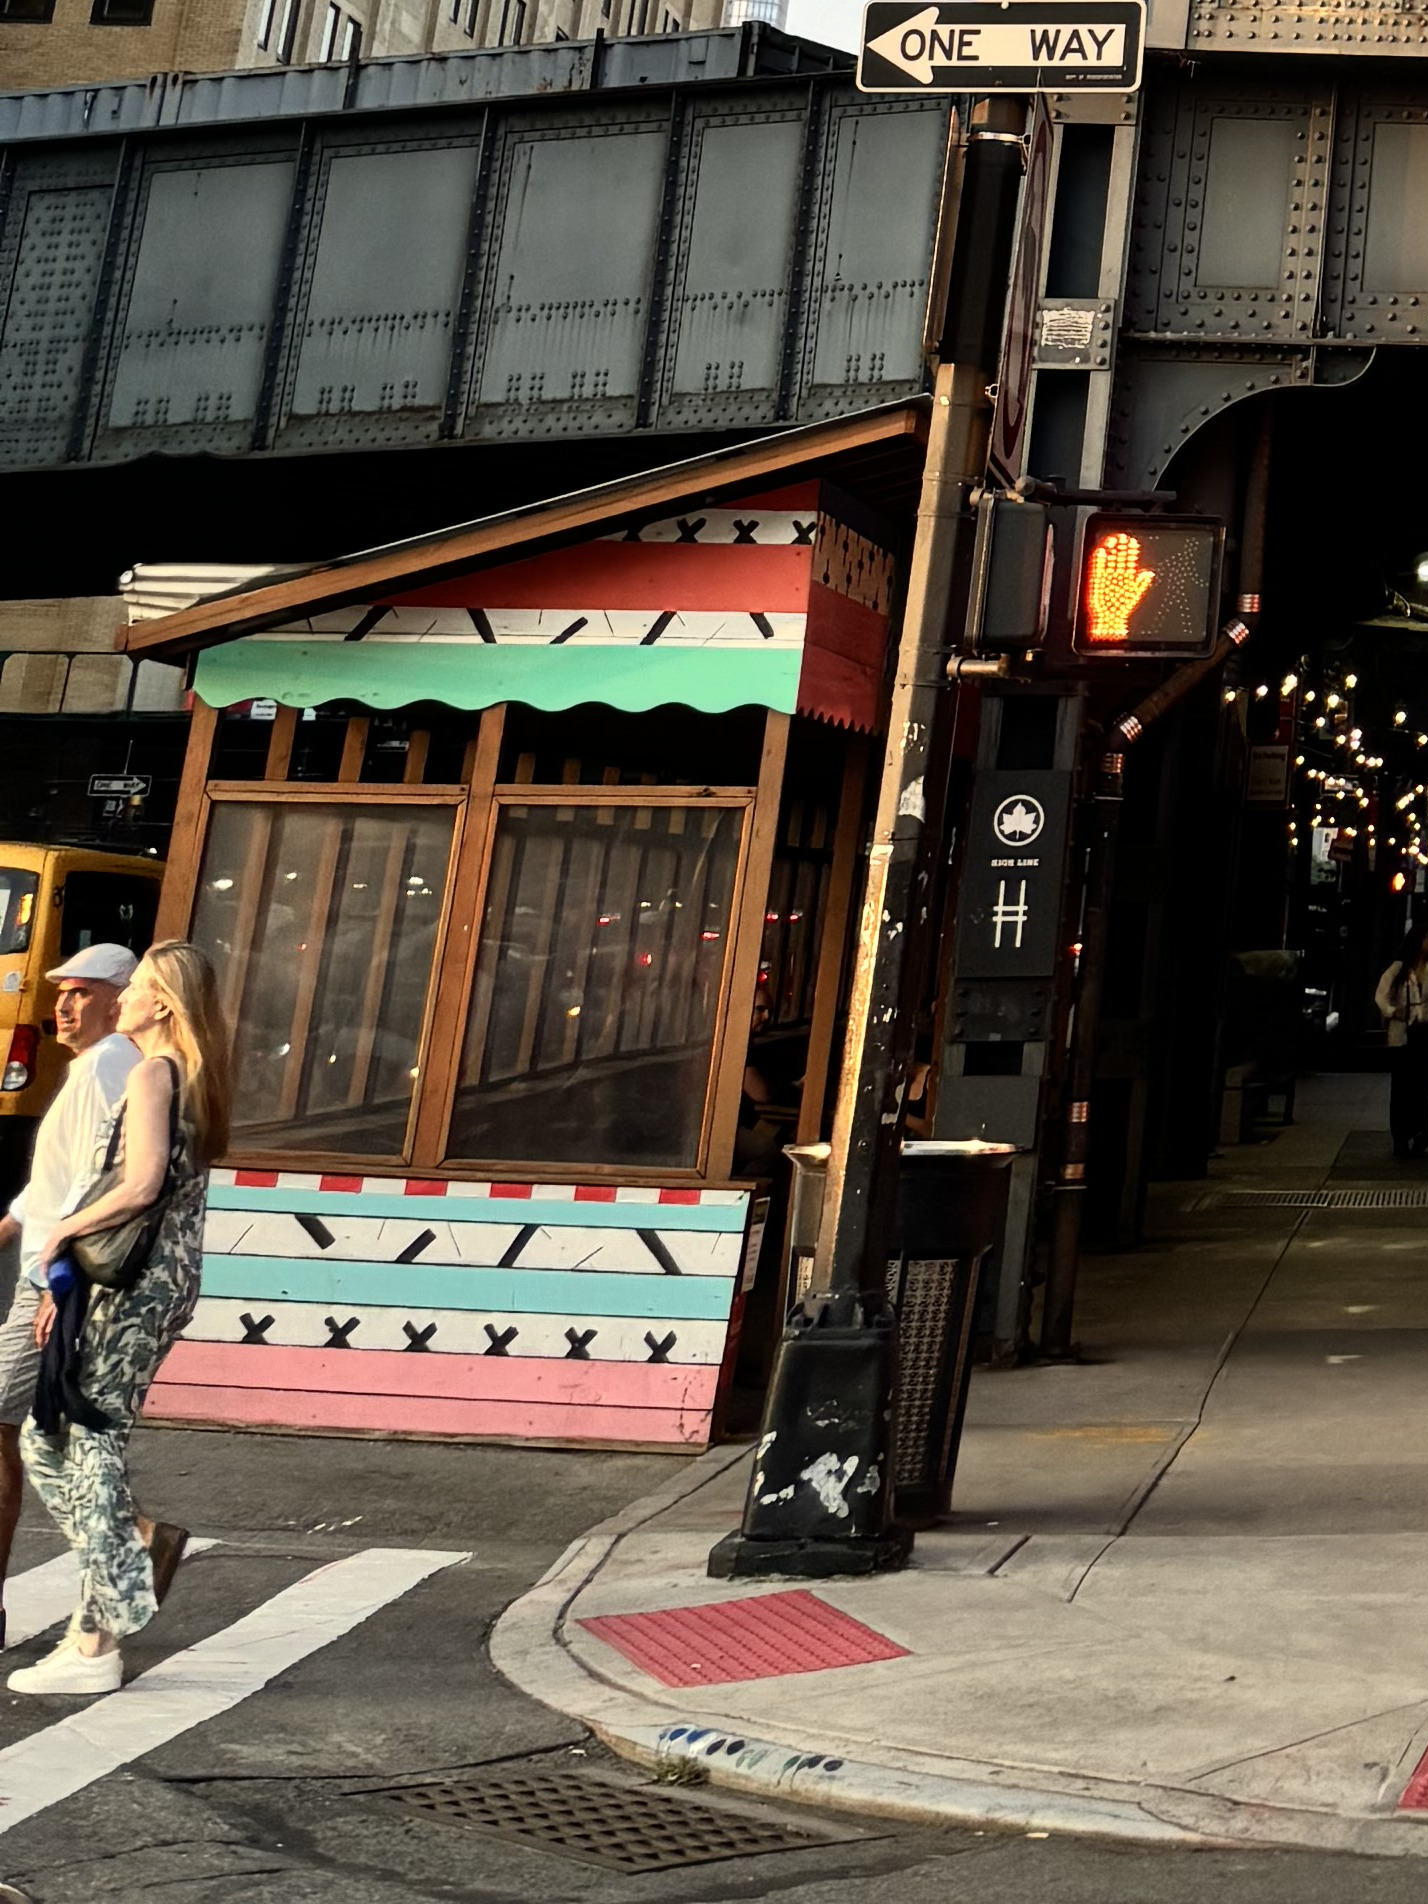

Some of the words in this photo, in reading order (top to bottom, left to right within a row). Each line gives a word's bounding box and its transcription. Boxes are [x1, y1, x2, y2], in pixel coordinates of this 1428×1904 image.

[900, 28, 982, 61] ONE
[1030, 28, 1115, 61] WAY
[991, 859, 1015, 867] HIGH
[1017, 858, 1040, 866] LINE
